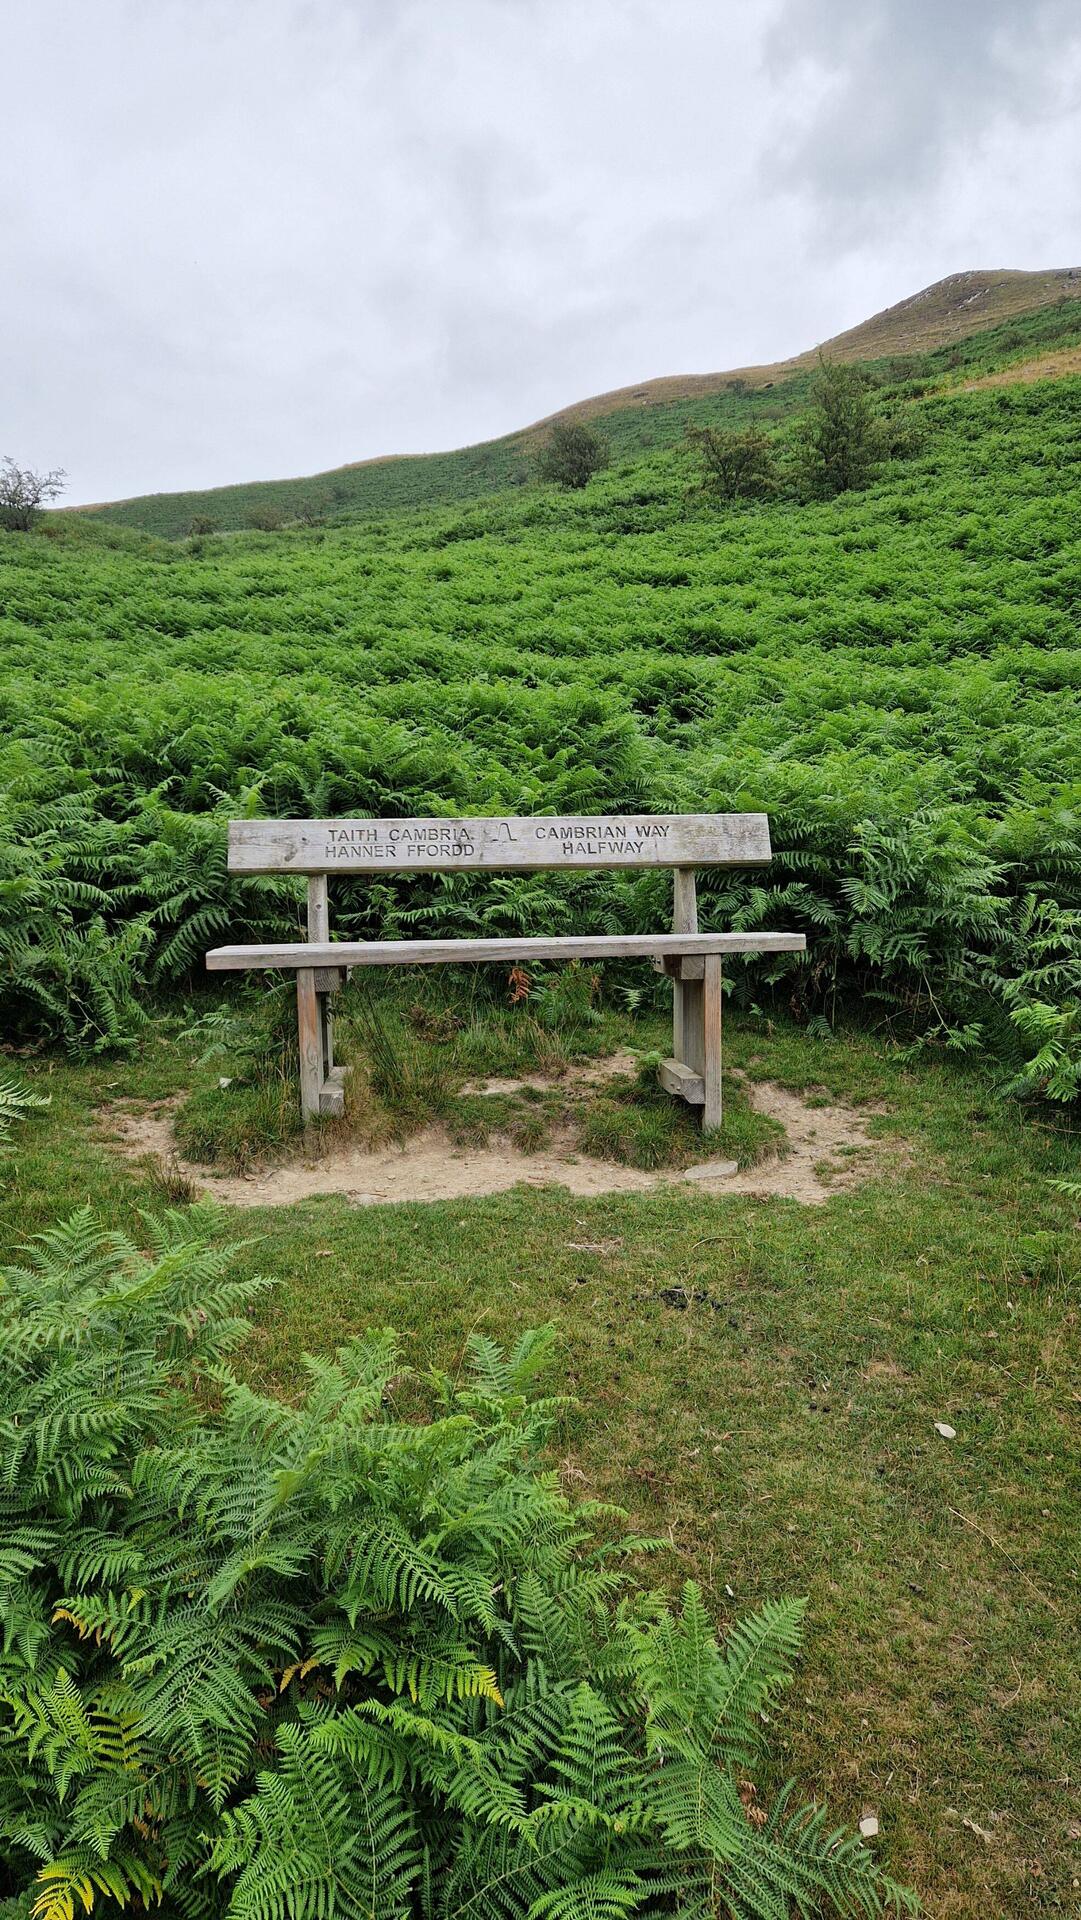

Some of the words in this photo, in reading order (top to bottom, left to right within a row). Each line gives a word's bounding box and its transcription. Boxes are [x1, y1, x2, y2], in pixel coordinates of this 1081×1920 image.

[328, 828, 378, 842] TAITH
[535, 825, 627, 840] CAMBRIAN
[636, 825, 670, 838] WAY
[325, 845, 397, 858] HANNER
[407, 844, 475, 857] FFORDD
[562, 841, 644, 855] HALFWAY
